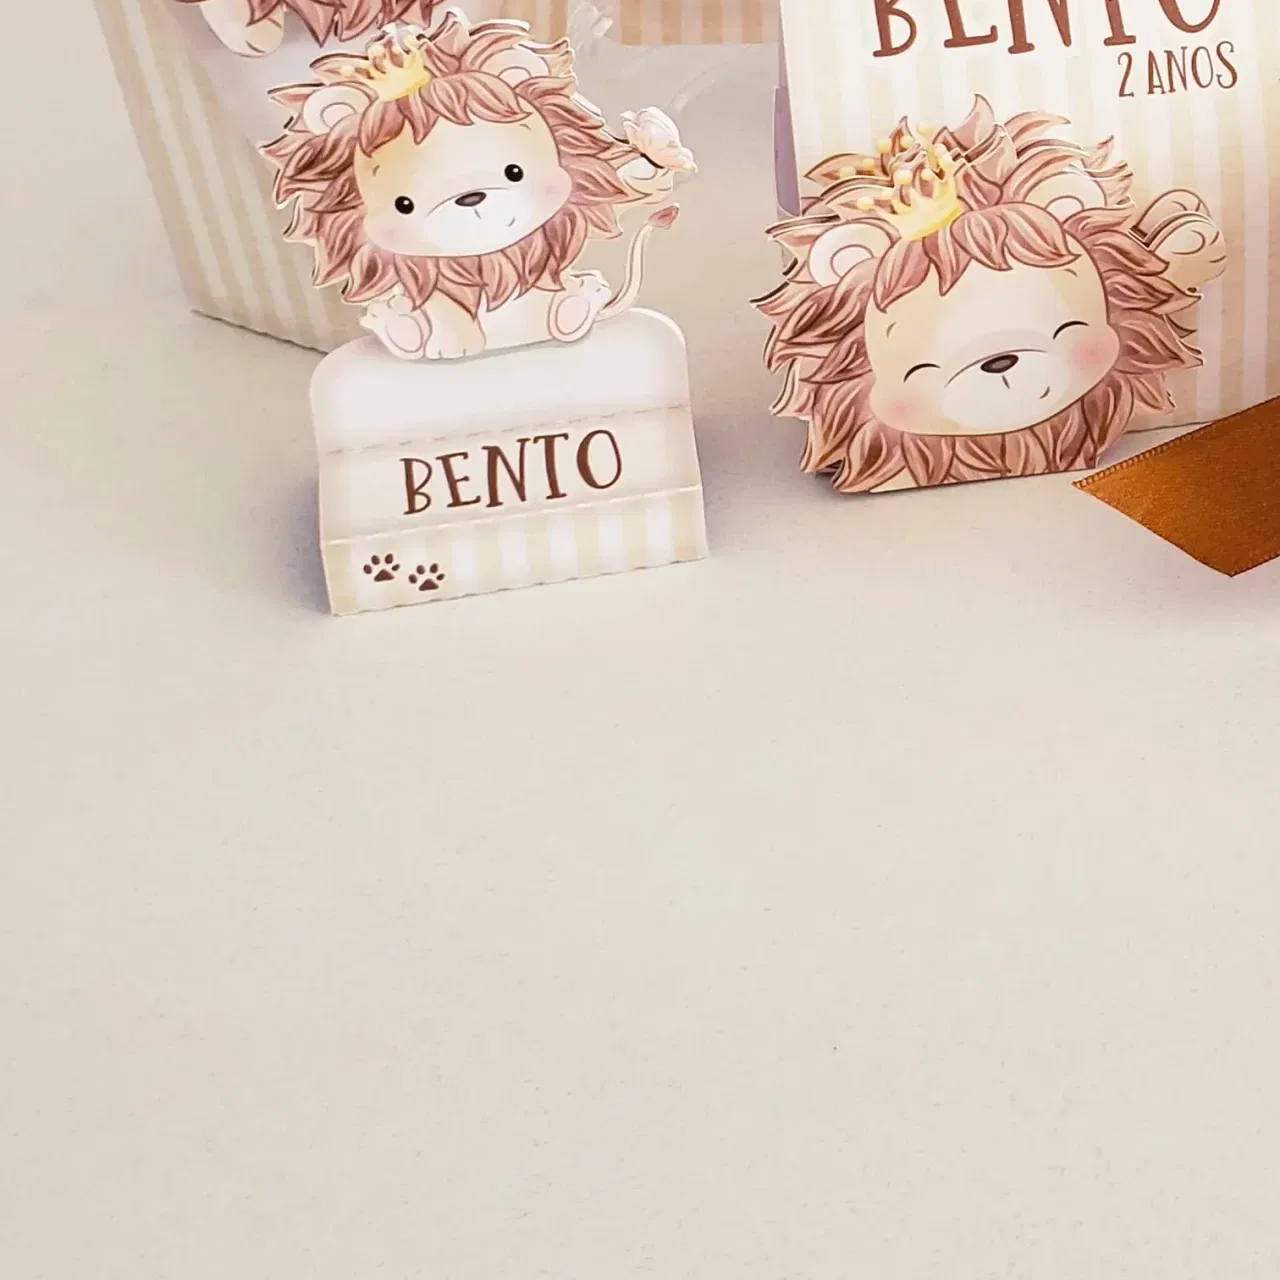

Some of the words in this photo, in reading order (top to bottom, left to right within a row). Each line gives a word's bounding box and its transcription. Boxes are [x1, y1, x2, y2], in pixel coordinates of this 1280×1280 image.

[1117, 53, 1136, 99] 2
[1146, 40, 1239, 96] ANOS
[399, 429, 623, 516] BENTO
